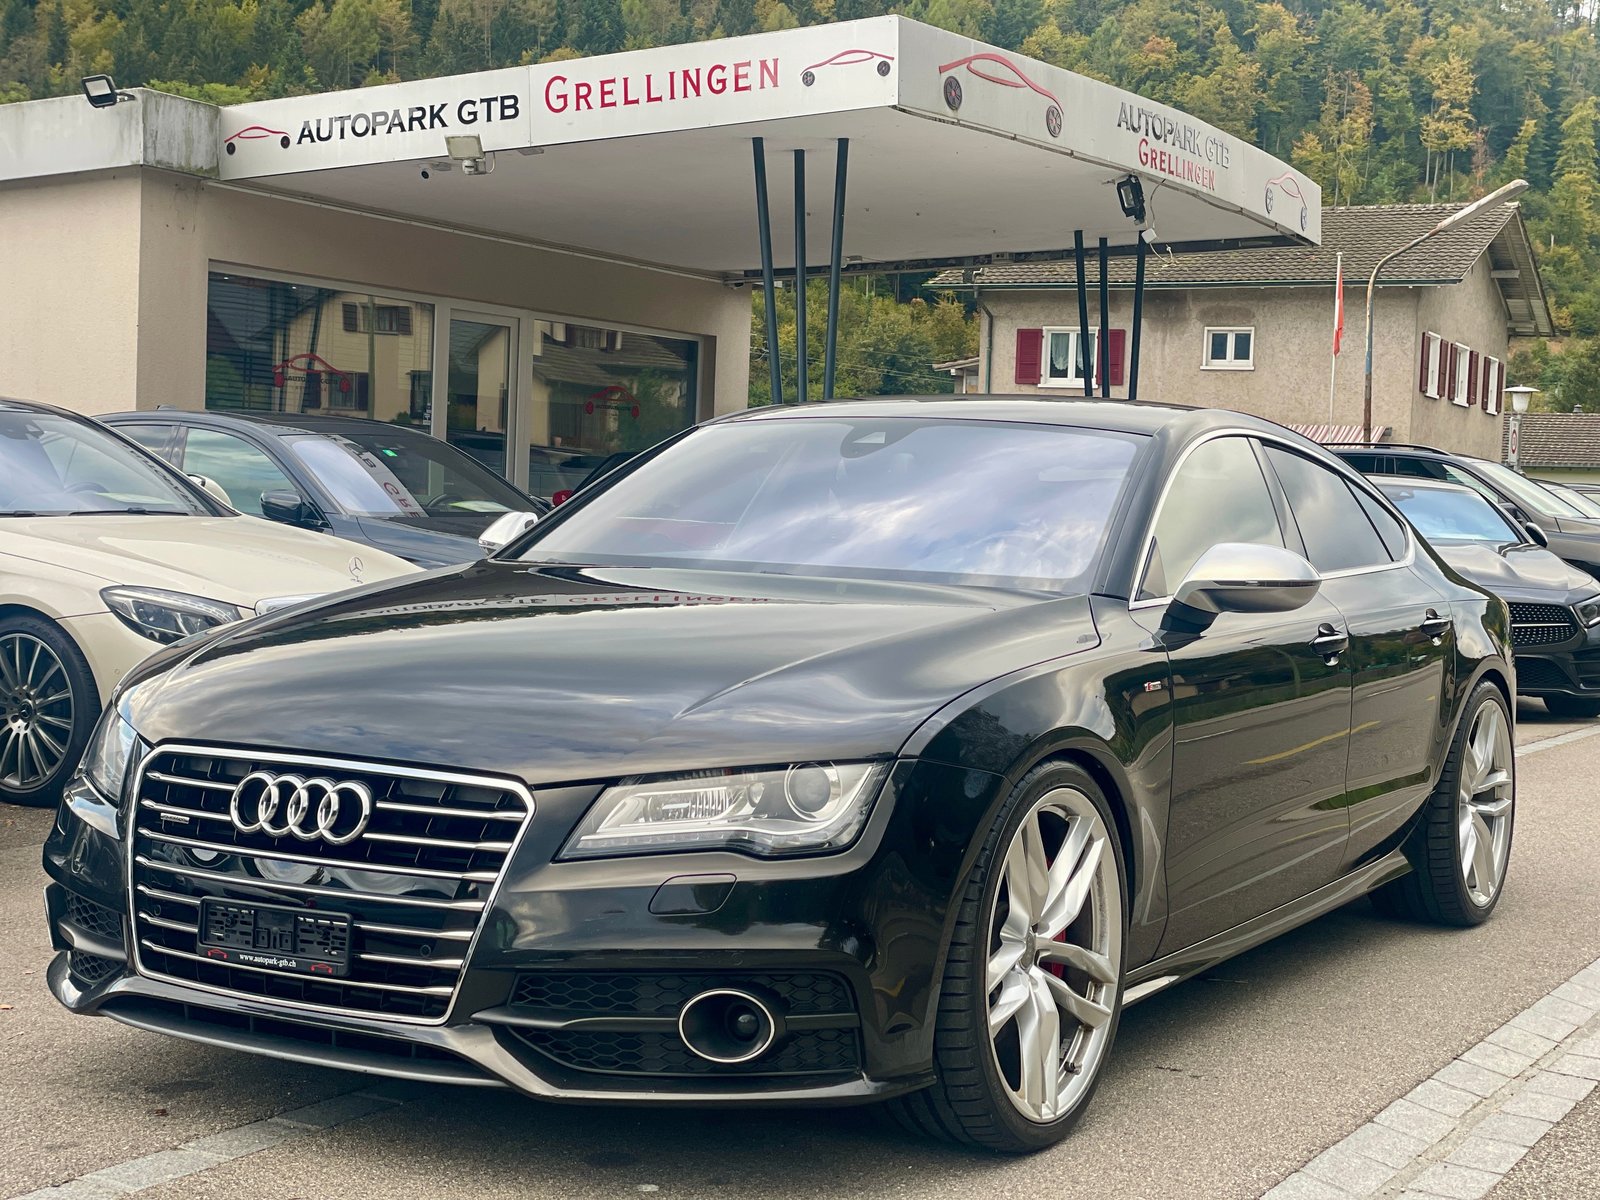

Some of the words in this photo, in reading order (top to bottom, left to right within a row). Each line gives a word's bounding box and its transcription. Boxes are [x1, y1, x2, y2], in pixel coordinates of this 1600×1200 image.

[297, 103, 449, 144] AUTOPARK
[457, 94, 520, 125] GTB
[544, 58, 780, 113] GRELLINGEN
[1117, 102, 1202, 157] AUTOPARK
[1205, 136, 1229, 169] GTB
[1138, 138, 1215, 191] GRELLINGEN
[239, 954, 297, 968] www.autopark-gtb.ch
